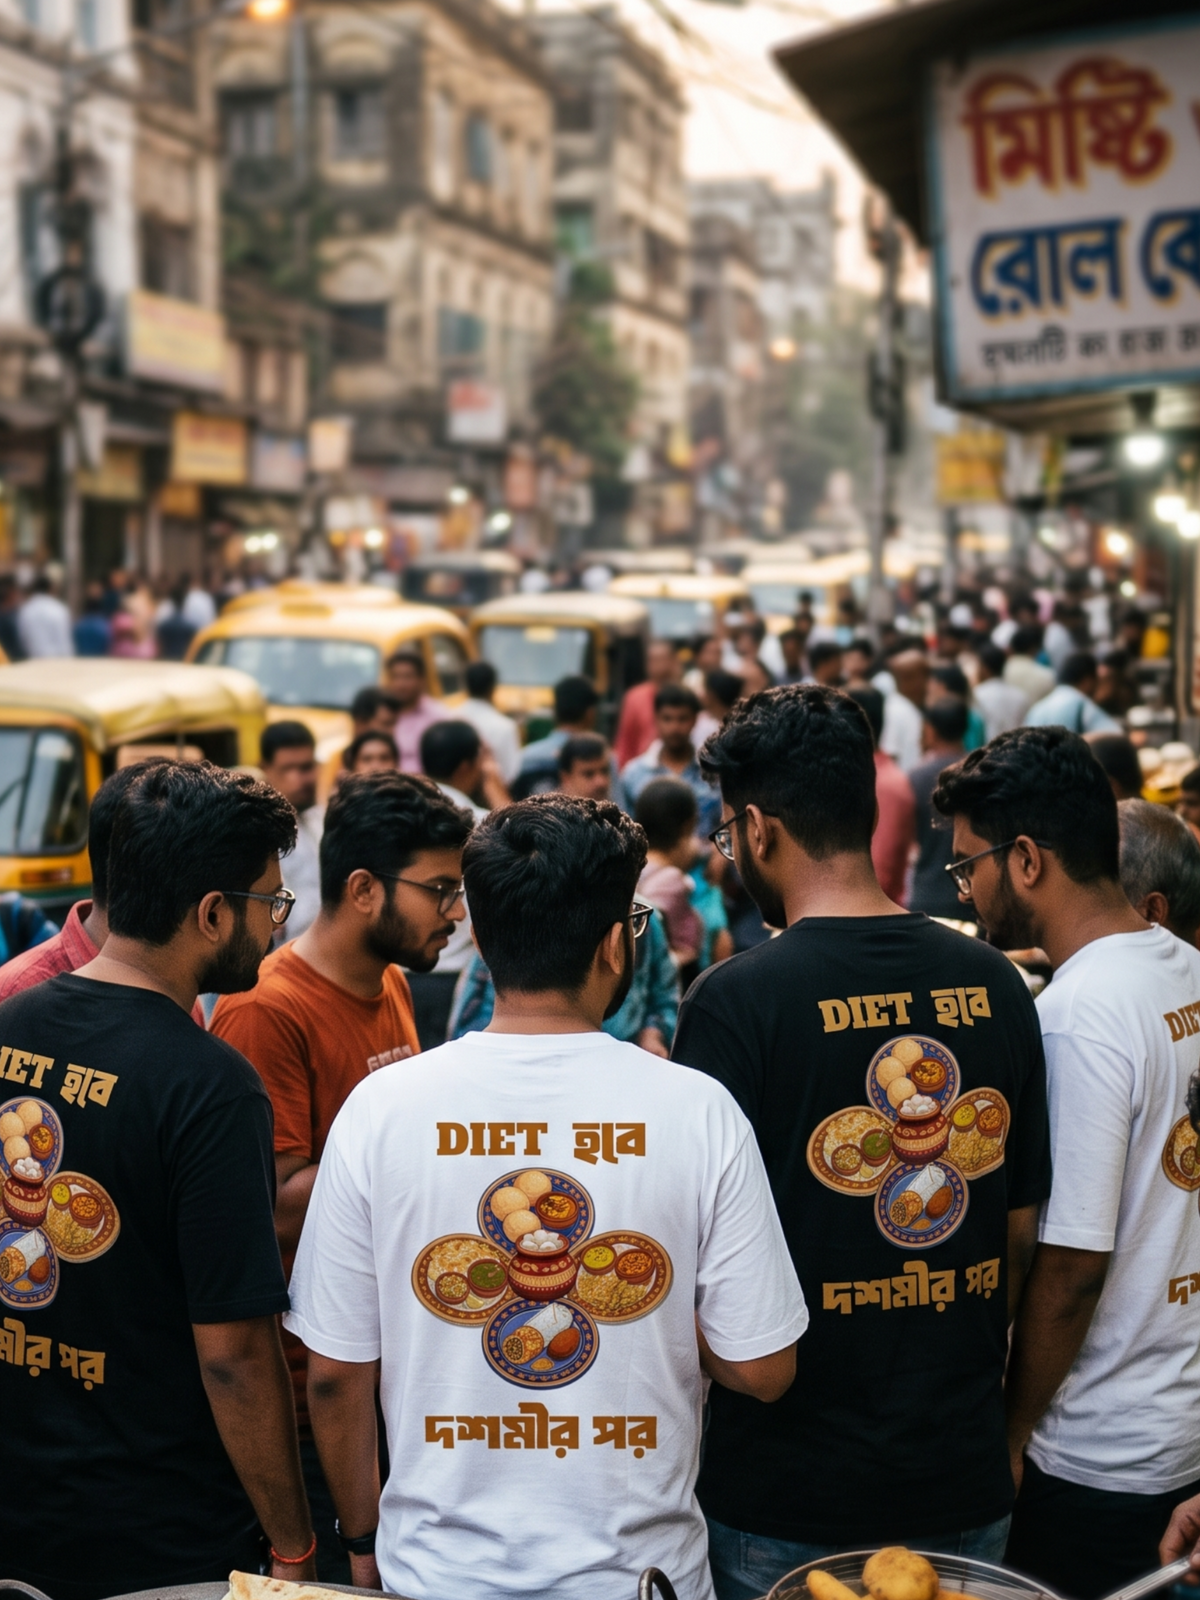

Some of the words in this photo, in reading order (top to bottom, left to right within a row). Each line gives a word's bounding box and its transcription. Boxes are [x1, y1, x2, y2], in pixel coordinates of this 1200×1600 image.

[961, 55, 1172, 198] মিষ্টি
[971, 216, 1127, 322] রোল
[817, 991, 913, 1033] DIET
[1163, 1001, 1200, 1042] DIE
[0, 1046, 55, 1089] IET
[436, 1122, 548, 1156] DIET
[822, 1260, 956, 1314] দশমীর
[965, 1257, 1000, 1299] পর
[59, 1342, 106, 1391] পর
[425, 1402, 579, 1459] দশমীর
[592, 1416, 657, 1459] পর
